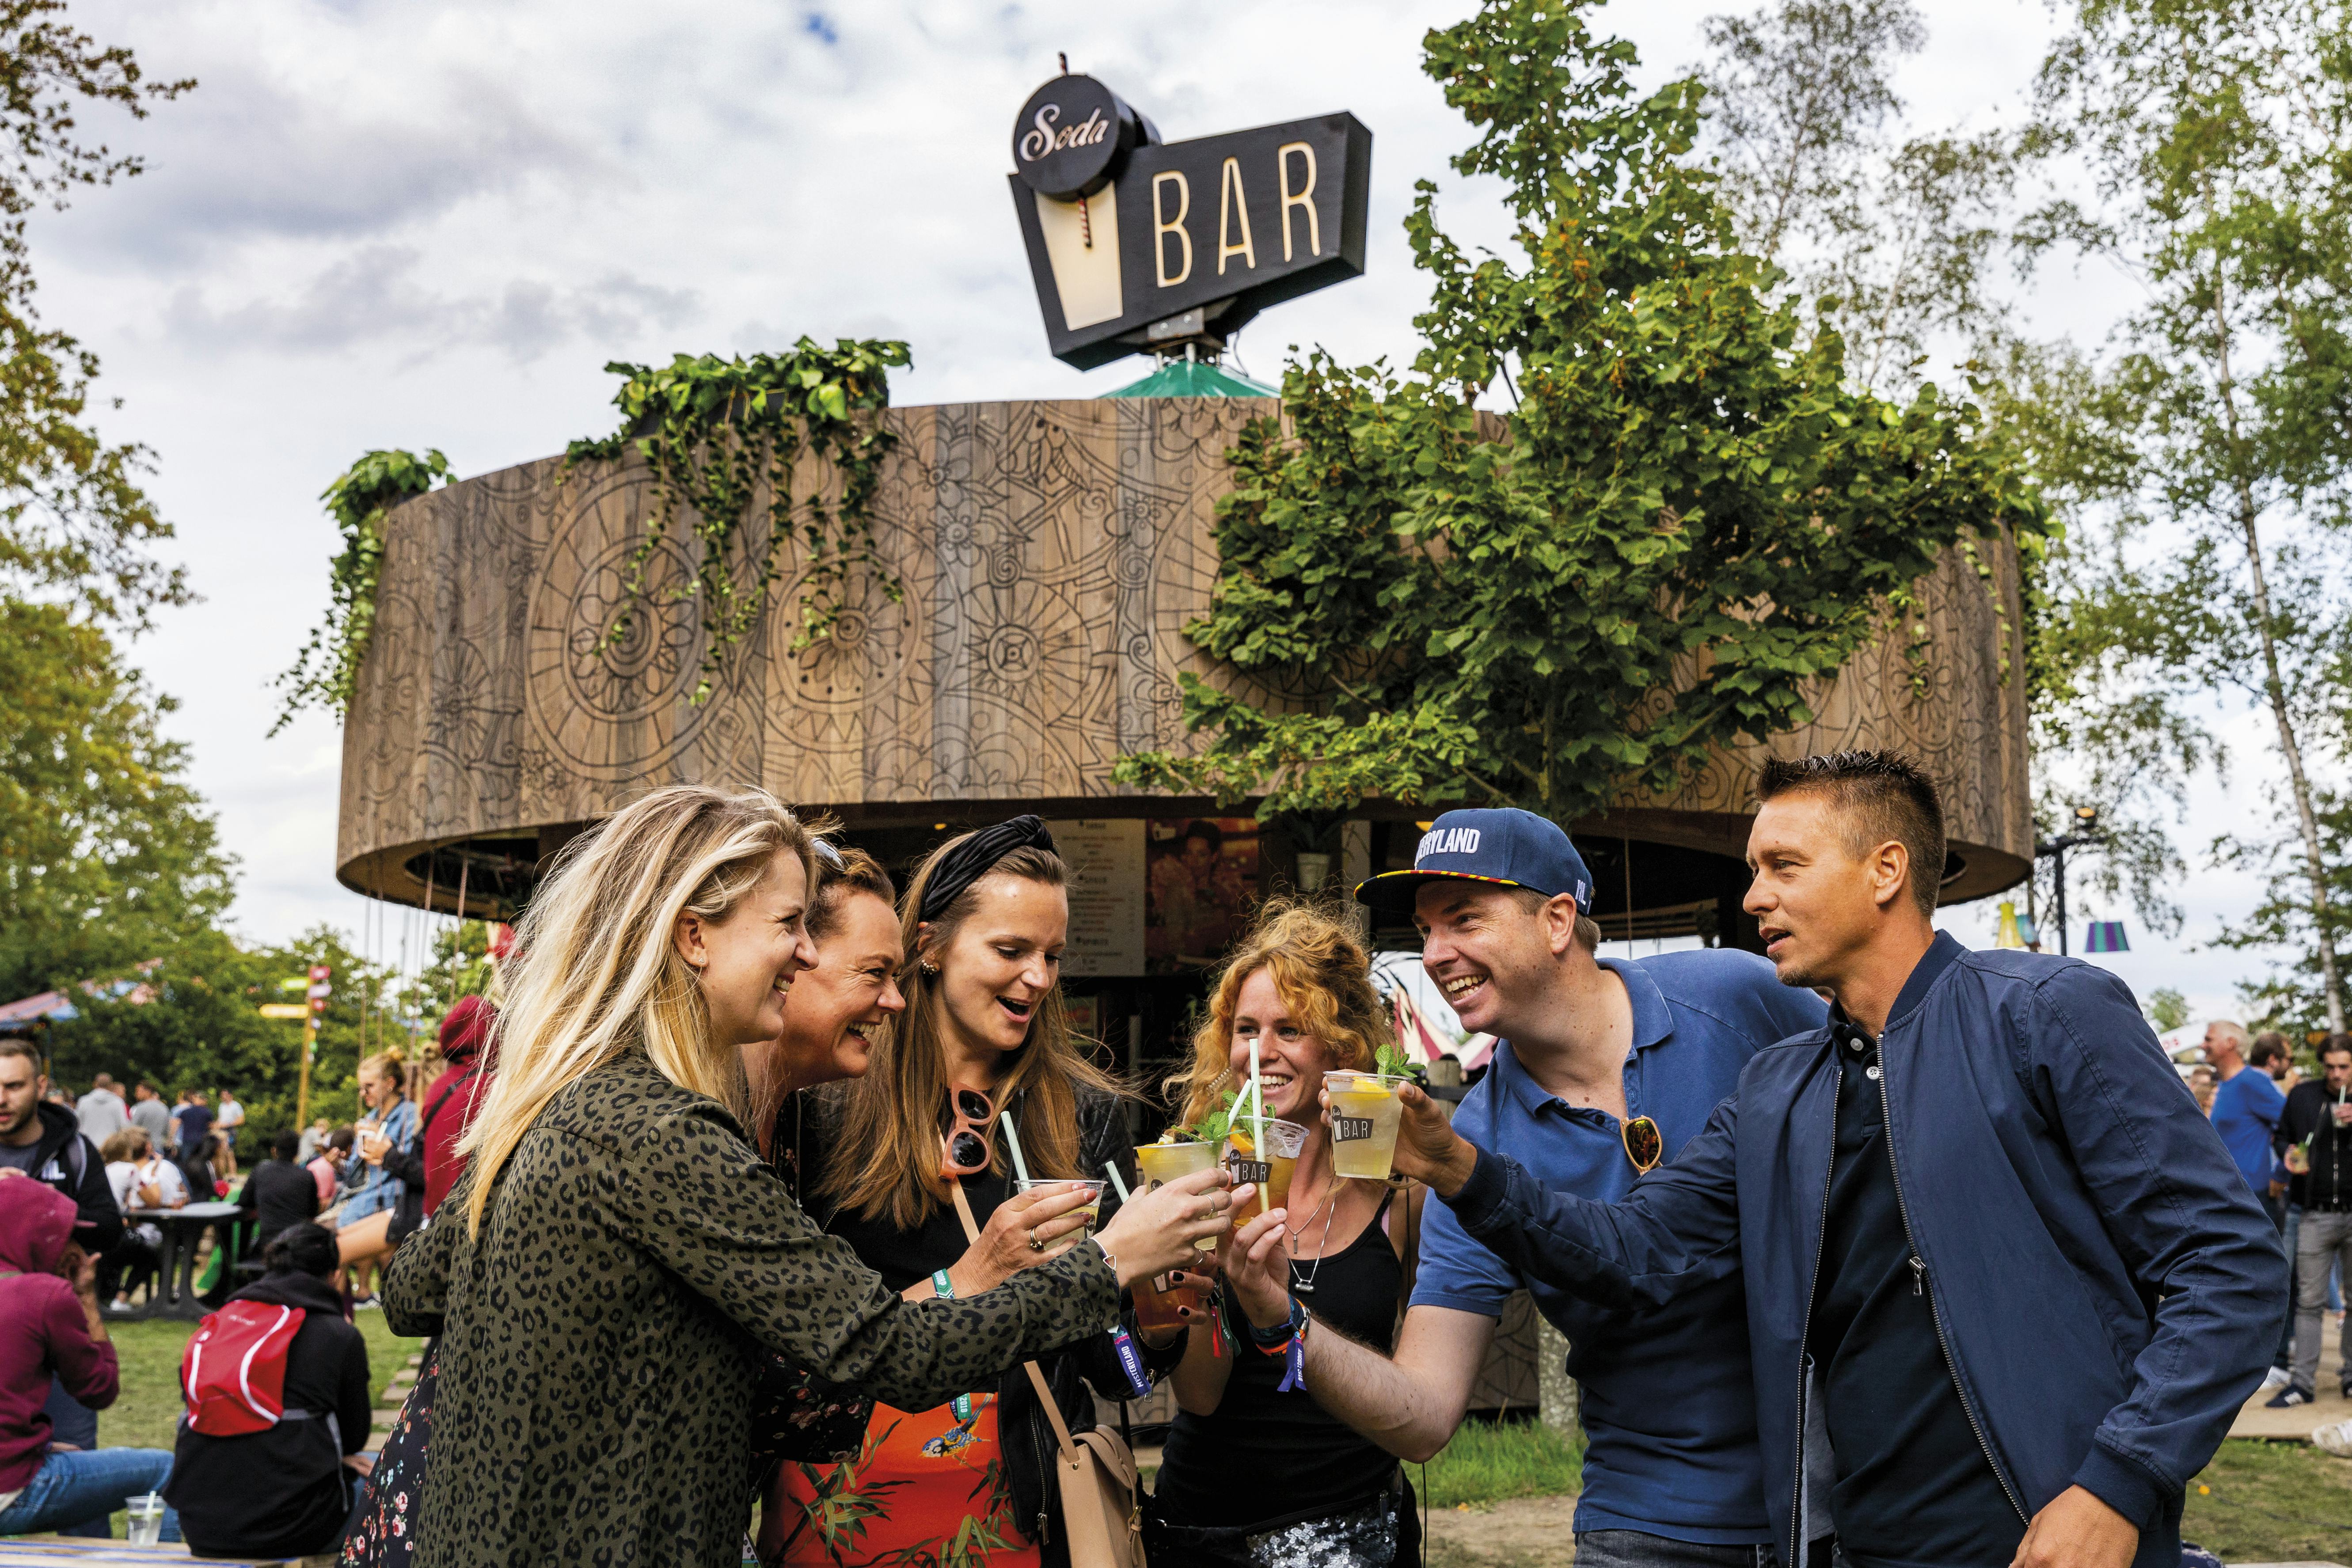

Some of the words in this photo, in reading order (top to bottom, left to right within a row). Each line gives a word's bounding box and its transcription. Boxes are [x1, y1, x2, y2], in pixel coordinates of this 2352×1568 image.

[1019, 103, 1110, 162] Soda
[1152, 141, 1321, 288] BAR
[1575, 879, 1586, 906] ML
[1343, 1120, 1368, 1138] BAR
[1230, 1153, 1240, 1162] Soda
[1242, 1163, 1267, 1181] BAR
[1121, 1345, 1144, 1388] MYSTERYLAND
[959, 1397, 968, 1413] 2018
